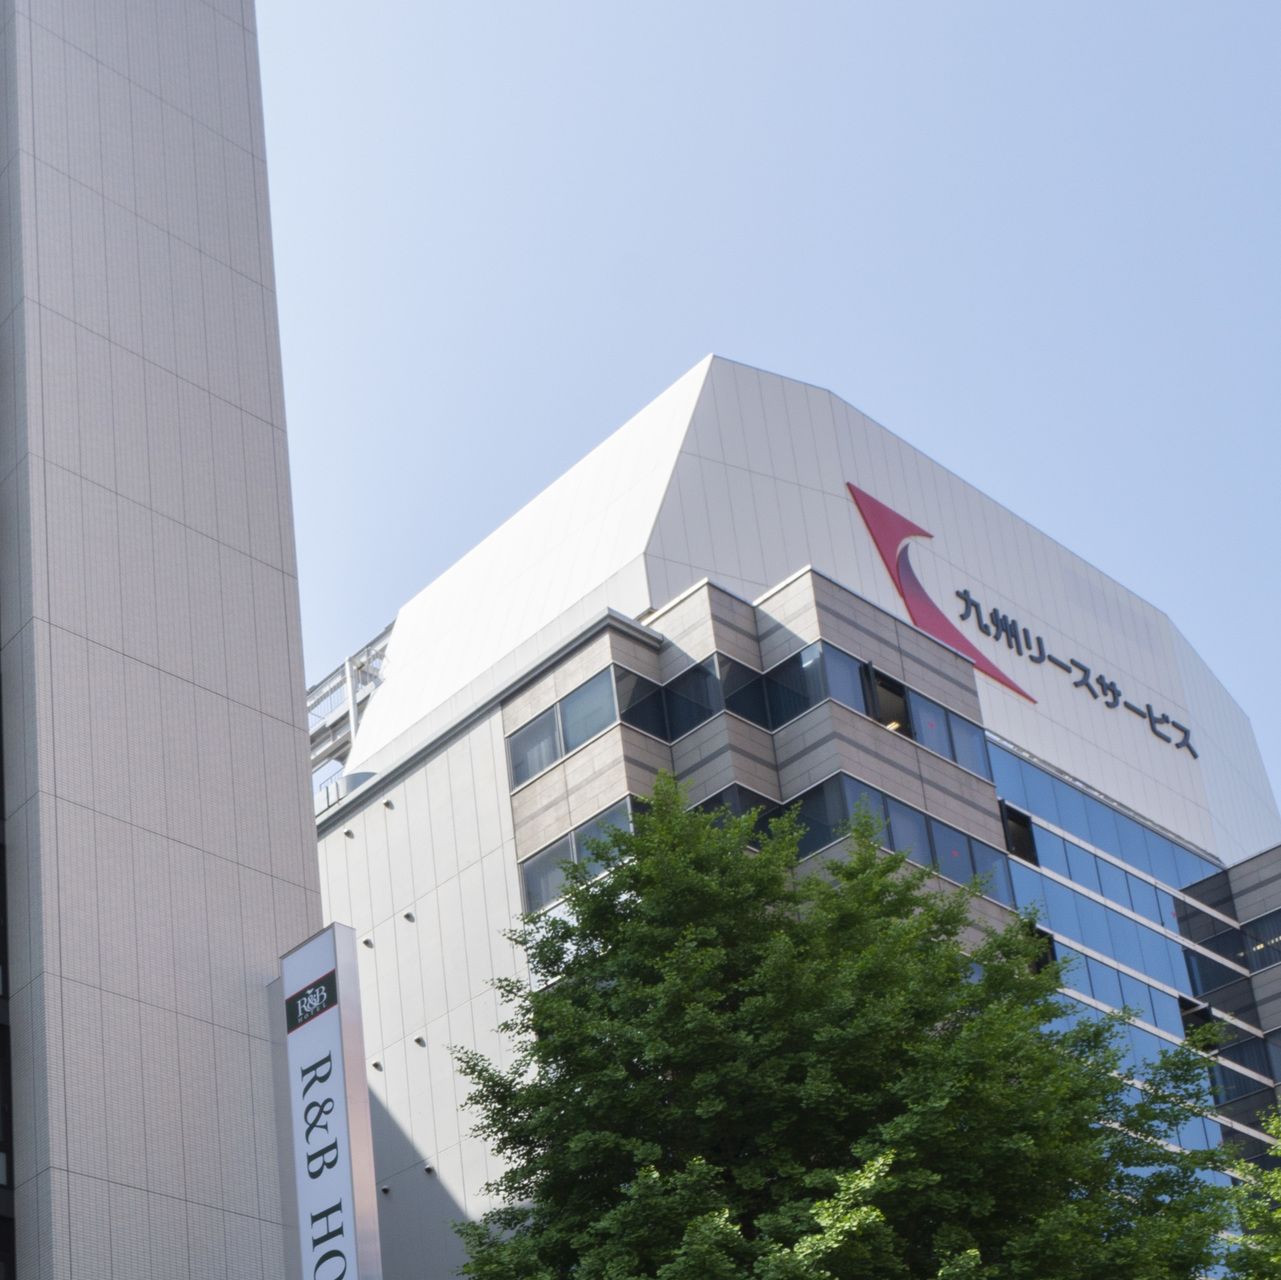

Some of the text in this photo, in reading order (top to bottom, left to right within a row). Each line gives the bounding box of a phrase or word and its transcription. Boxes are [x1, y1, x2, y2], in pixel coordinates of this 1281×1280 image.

[956, 589, 1199, 759] 九州リースサービス
[296, 985, 328, 1018] R&B
[300, 1050, 339, 1181] R&B
